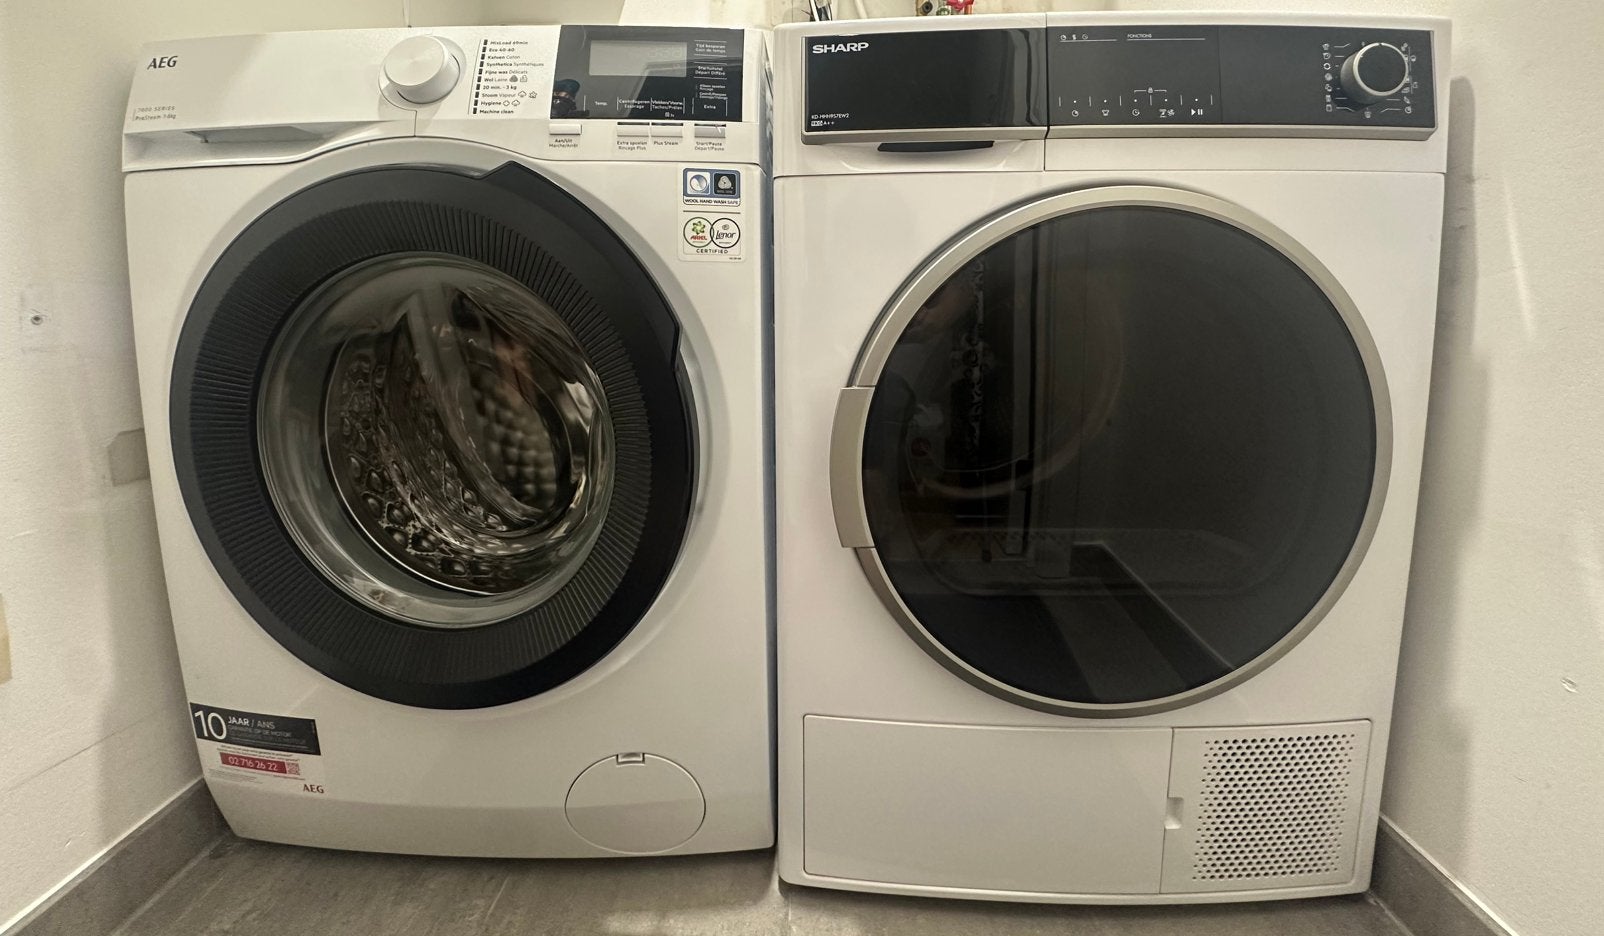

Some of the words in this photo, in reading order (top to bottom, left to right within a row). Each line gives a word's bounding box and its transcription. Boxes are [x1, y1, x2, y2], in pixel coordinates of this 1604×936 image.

[812, 42, 869, 54] SHARP
[147, 56, 178, 70] AEG
[716, 230, 736, 240] Lenor
[194, 710, 227, 740] 10
[228, 716, 250, 726] JAAR
[257, 720, 275, 730] ANS
[228, 756, 239, 765] 02
[240, 758, 254, 767] 716
[255, 761, 265, 769] 26
[268, 762, 278, 771] 22
[303, 784, 324, 794] AEG
